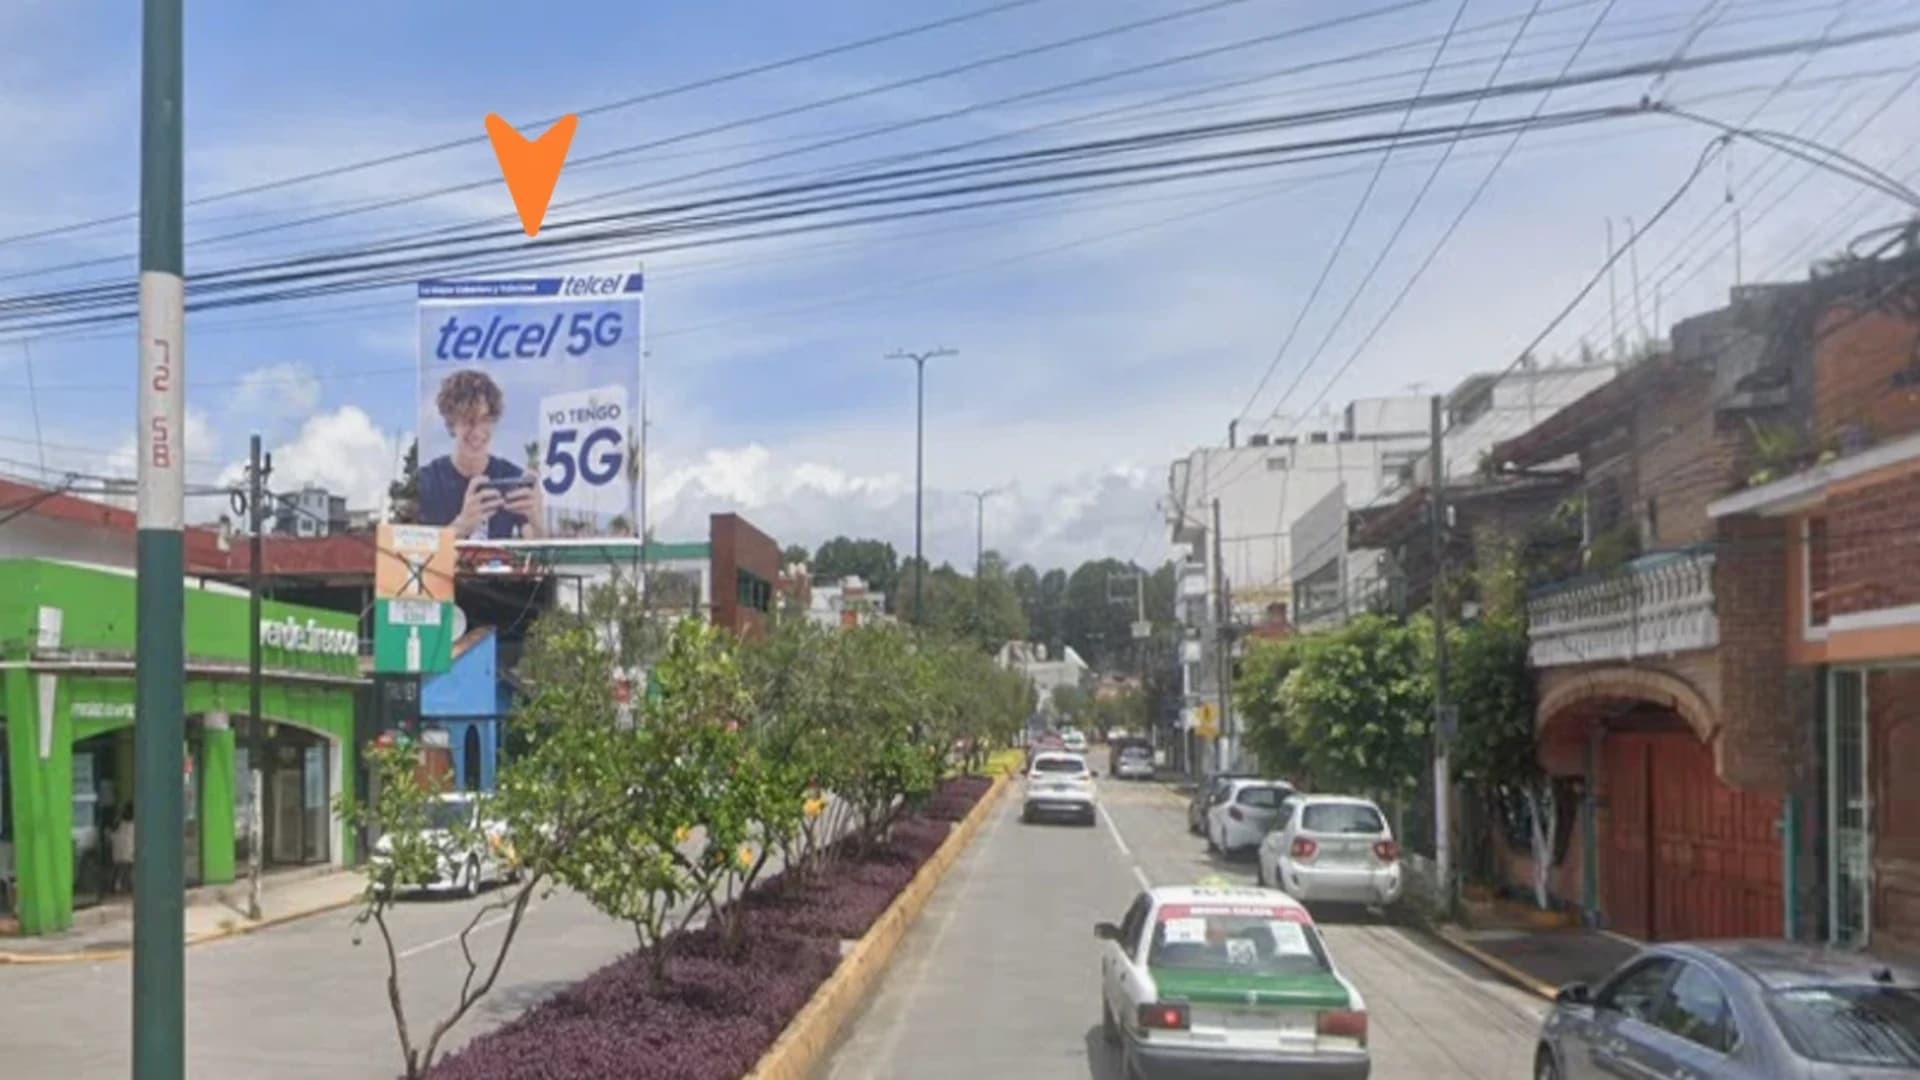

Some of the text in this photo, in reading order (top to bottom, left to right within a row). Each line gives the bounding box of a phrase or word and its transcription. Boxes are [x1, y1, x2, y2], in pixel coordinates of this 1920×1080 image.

[564, 274, 623, 296] telcel
[435, 312, 623, 360] telcel 5G
[547, 405, 621, 425] YO TENGO
[542, 427, 623, 495] 5G
